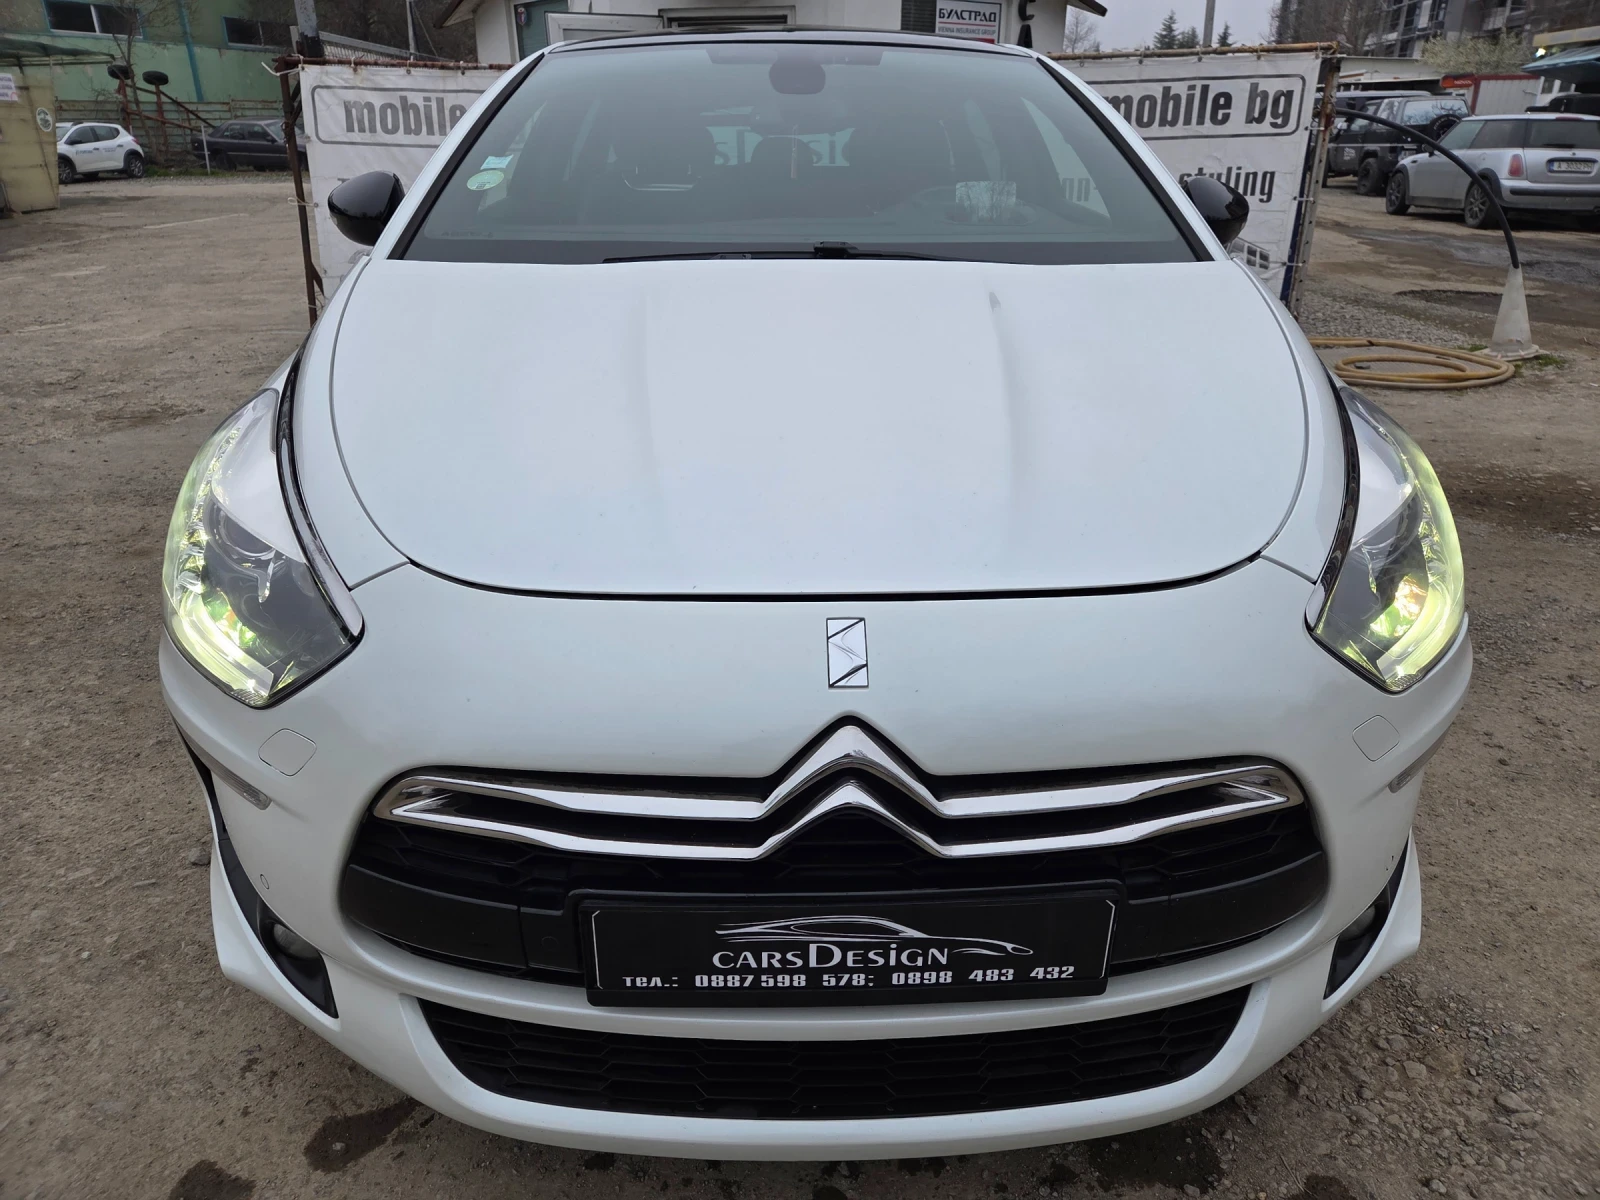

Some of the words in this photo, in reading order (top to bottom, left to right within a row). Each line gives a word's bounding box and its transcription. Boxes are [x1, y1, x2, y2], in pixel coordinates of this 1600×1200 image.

[938, 8, 997, 22] БУЛСТРАД
[955, 27, 981, 36] INSURANCE
[1245, 82, 1295, 129] bg
[695, 974, 754, 988] 0887
[761, 974, 806, 987] 598
[892, 971, 953, 985] 0898
[968, 968, 1014, 982] 483
[1029, 966, 1075, 979] 432
